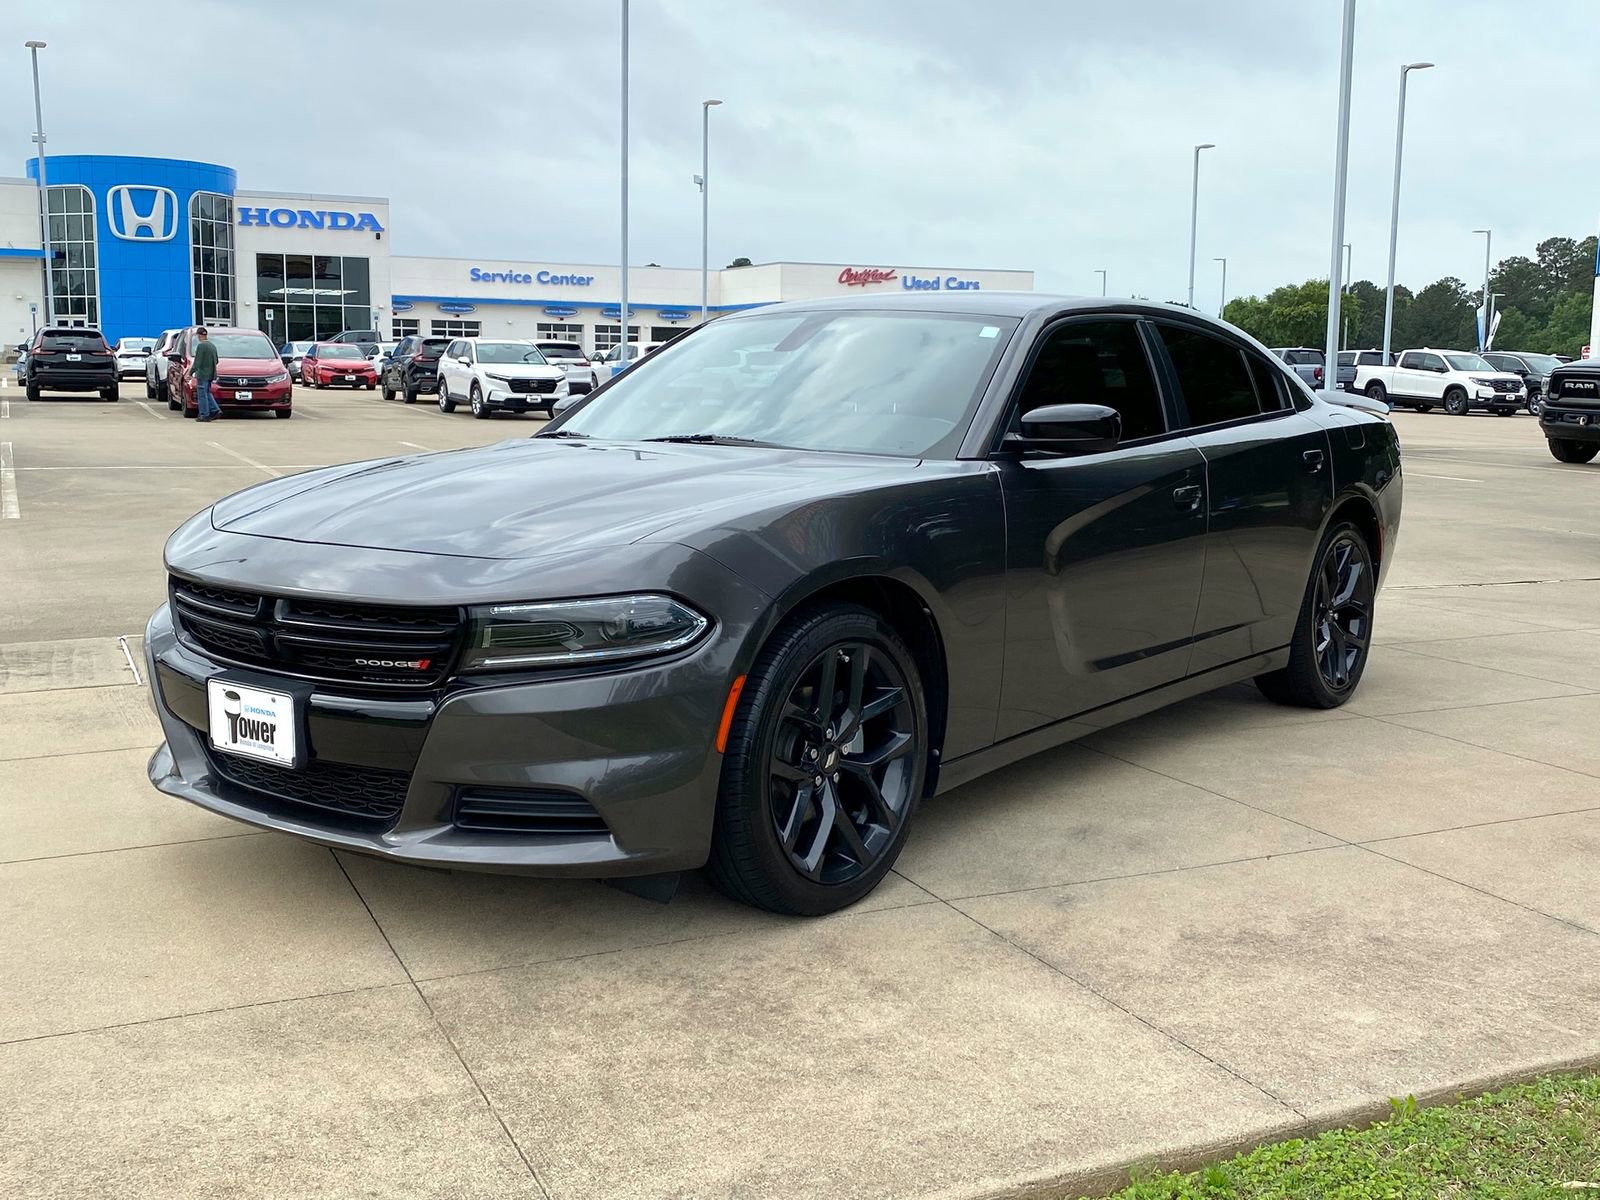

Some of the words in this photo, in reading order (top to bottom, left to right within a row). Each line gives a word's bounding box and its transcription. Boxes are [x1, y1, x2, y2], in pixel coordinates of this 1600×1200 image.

[238, 207, 385, 232] HONDA
[470, 267, 532, 284] Service
[537, 270, 594, 286] Center
[838, 267, 898, 287] Certified
[902, 275, 940, 290] Used
[944, 277, 980, 290] Cars
[355, 658, 420, 668] DODGE
[224, 698, 276, 744] Tower
[250, 706, 276, 717] HONDA
